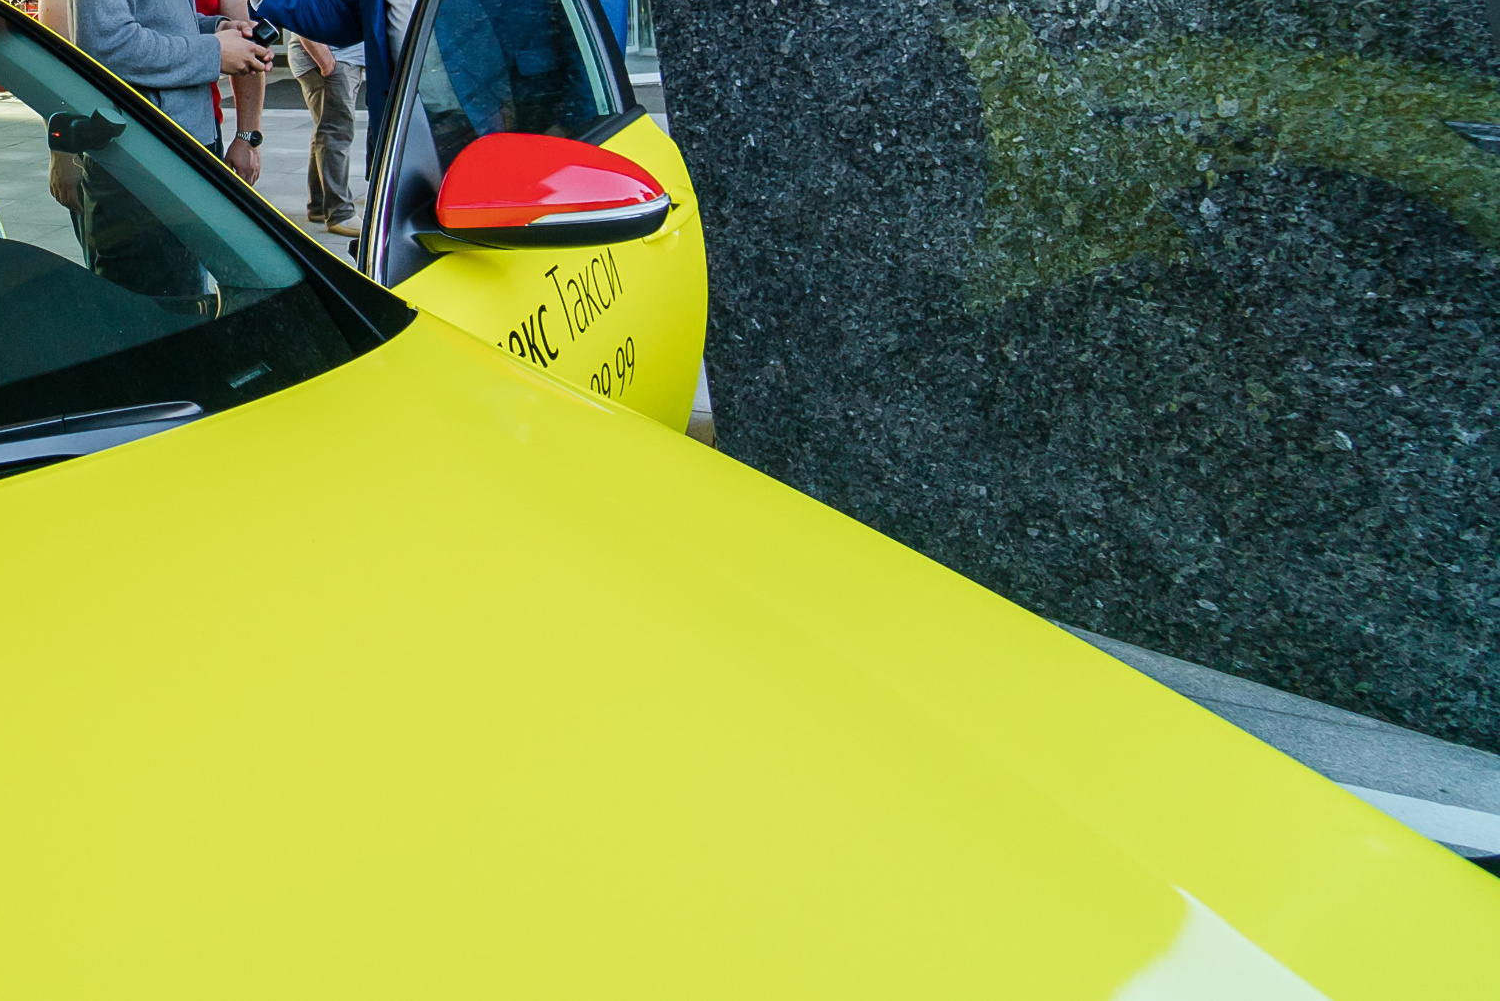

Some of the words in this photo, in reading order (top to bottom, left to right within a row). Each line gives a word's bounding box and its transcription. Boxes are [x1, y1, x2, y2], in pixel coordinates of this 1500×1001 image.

[496, 303, 560, 369] екс
[545, 246, 623, 342] Такси
[615, 336, 635, 397] 99
